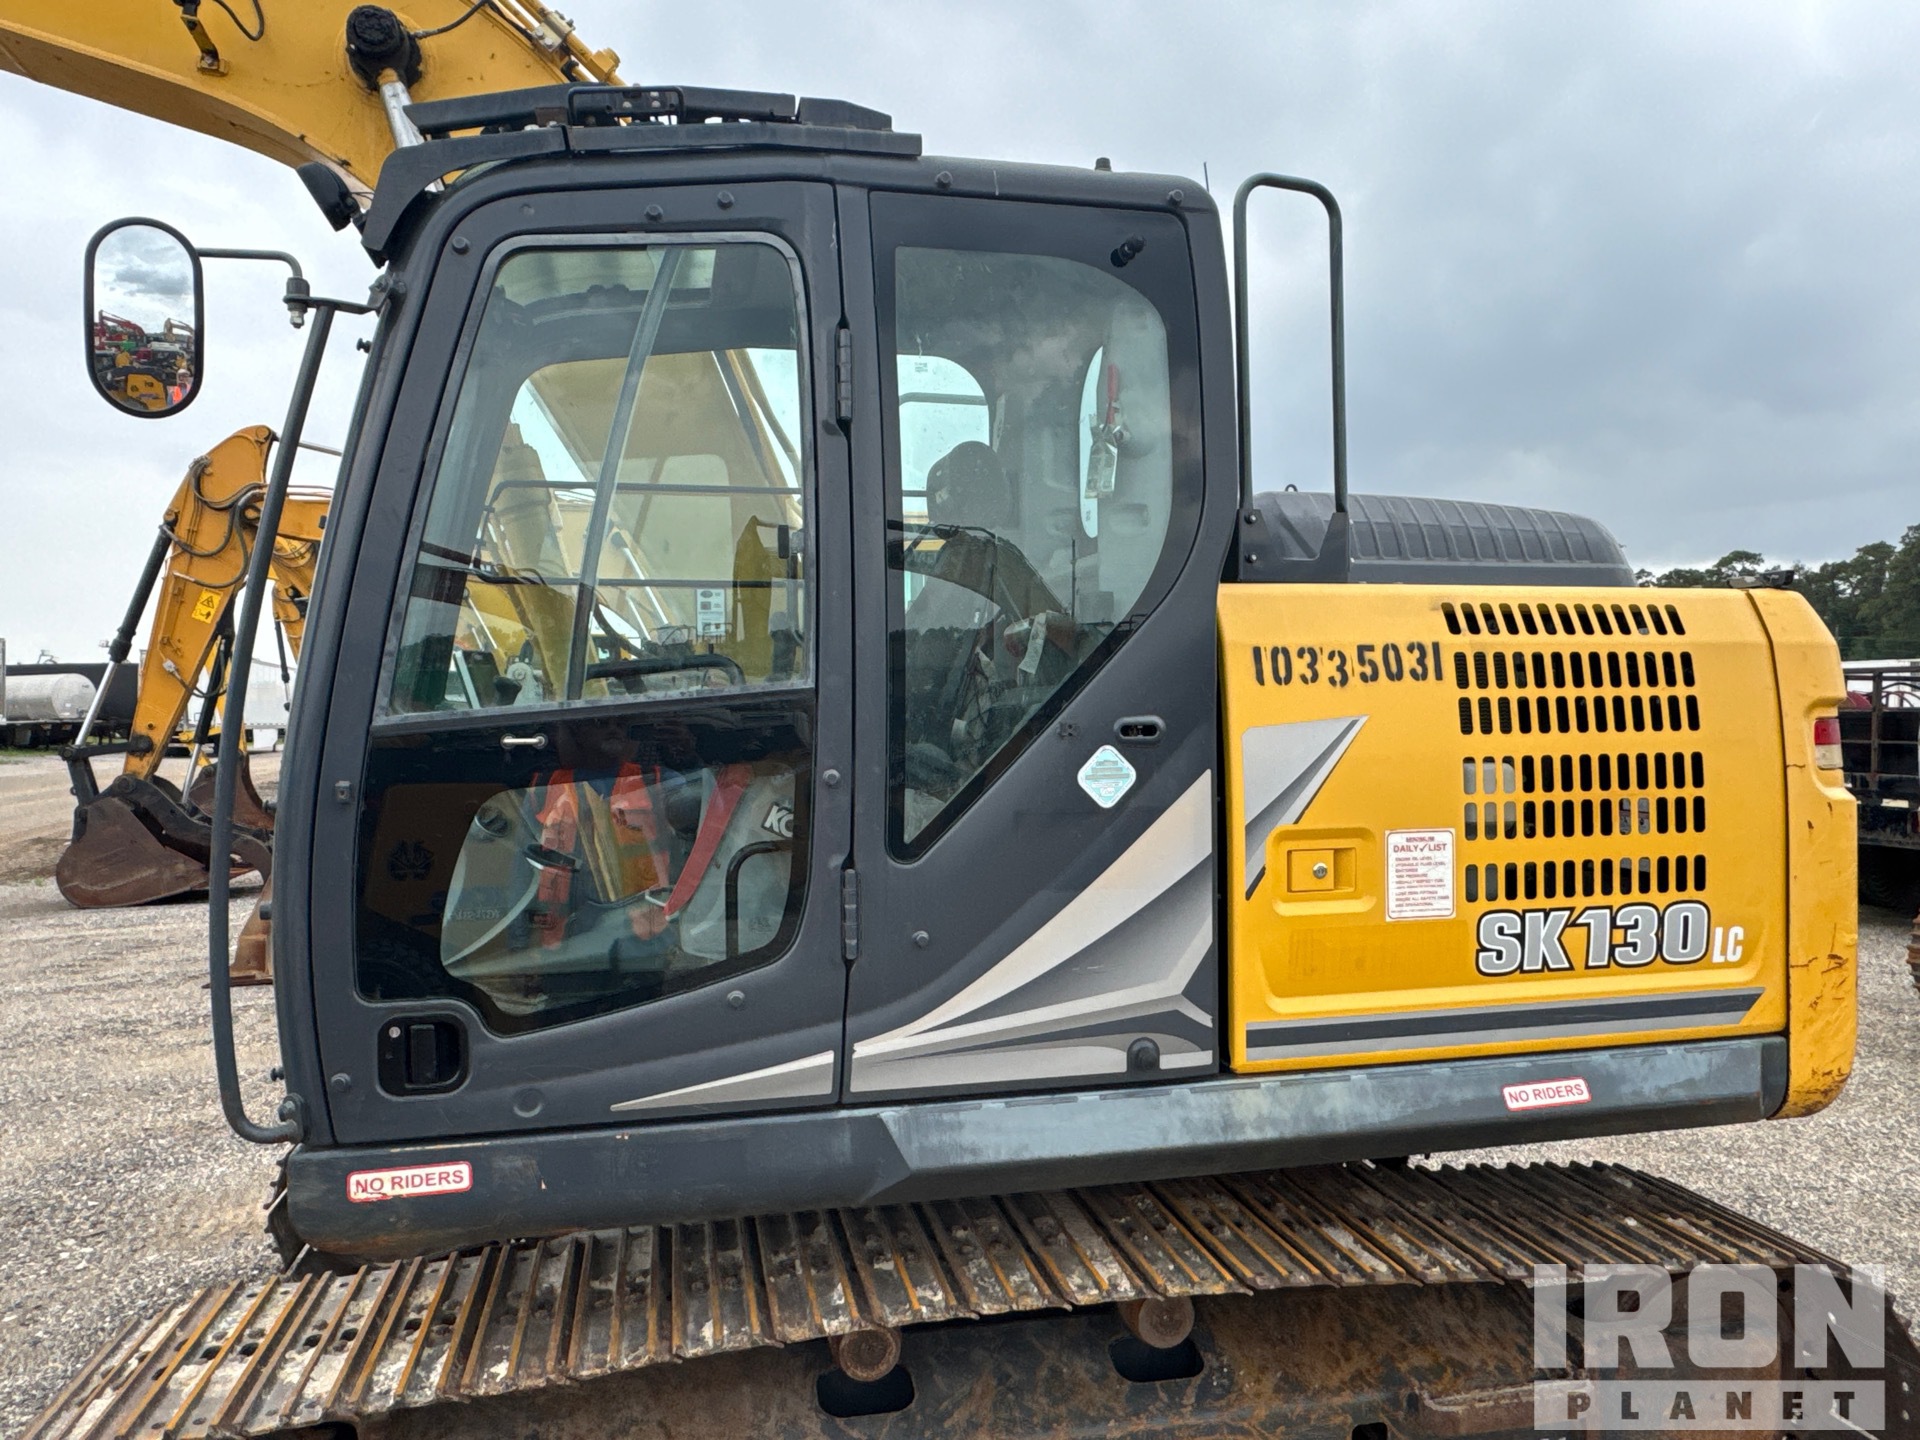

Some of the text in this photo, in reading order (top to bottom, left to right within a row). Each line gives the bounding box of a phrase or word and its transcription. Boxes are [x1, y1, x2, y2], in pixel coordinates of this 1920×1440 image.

[1253, 641, 1443, 688] 10335031
[1393, 843, 1447, 853] DAILY LIST
[1477, 901, 1744, 976] SK130 LC
[1507, 1083, 1584, 1103] NO RIDERS
[355, 1169, 464, 1193] NO RIDERS
